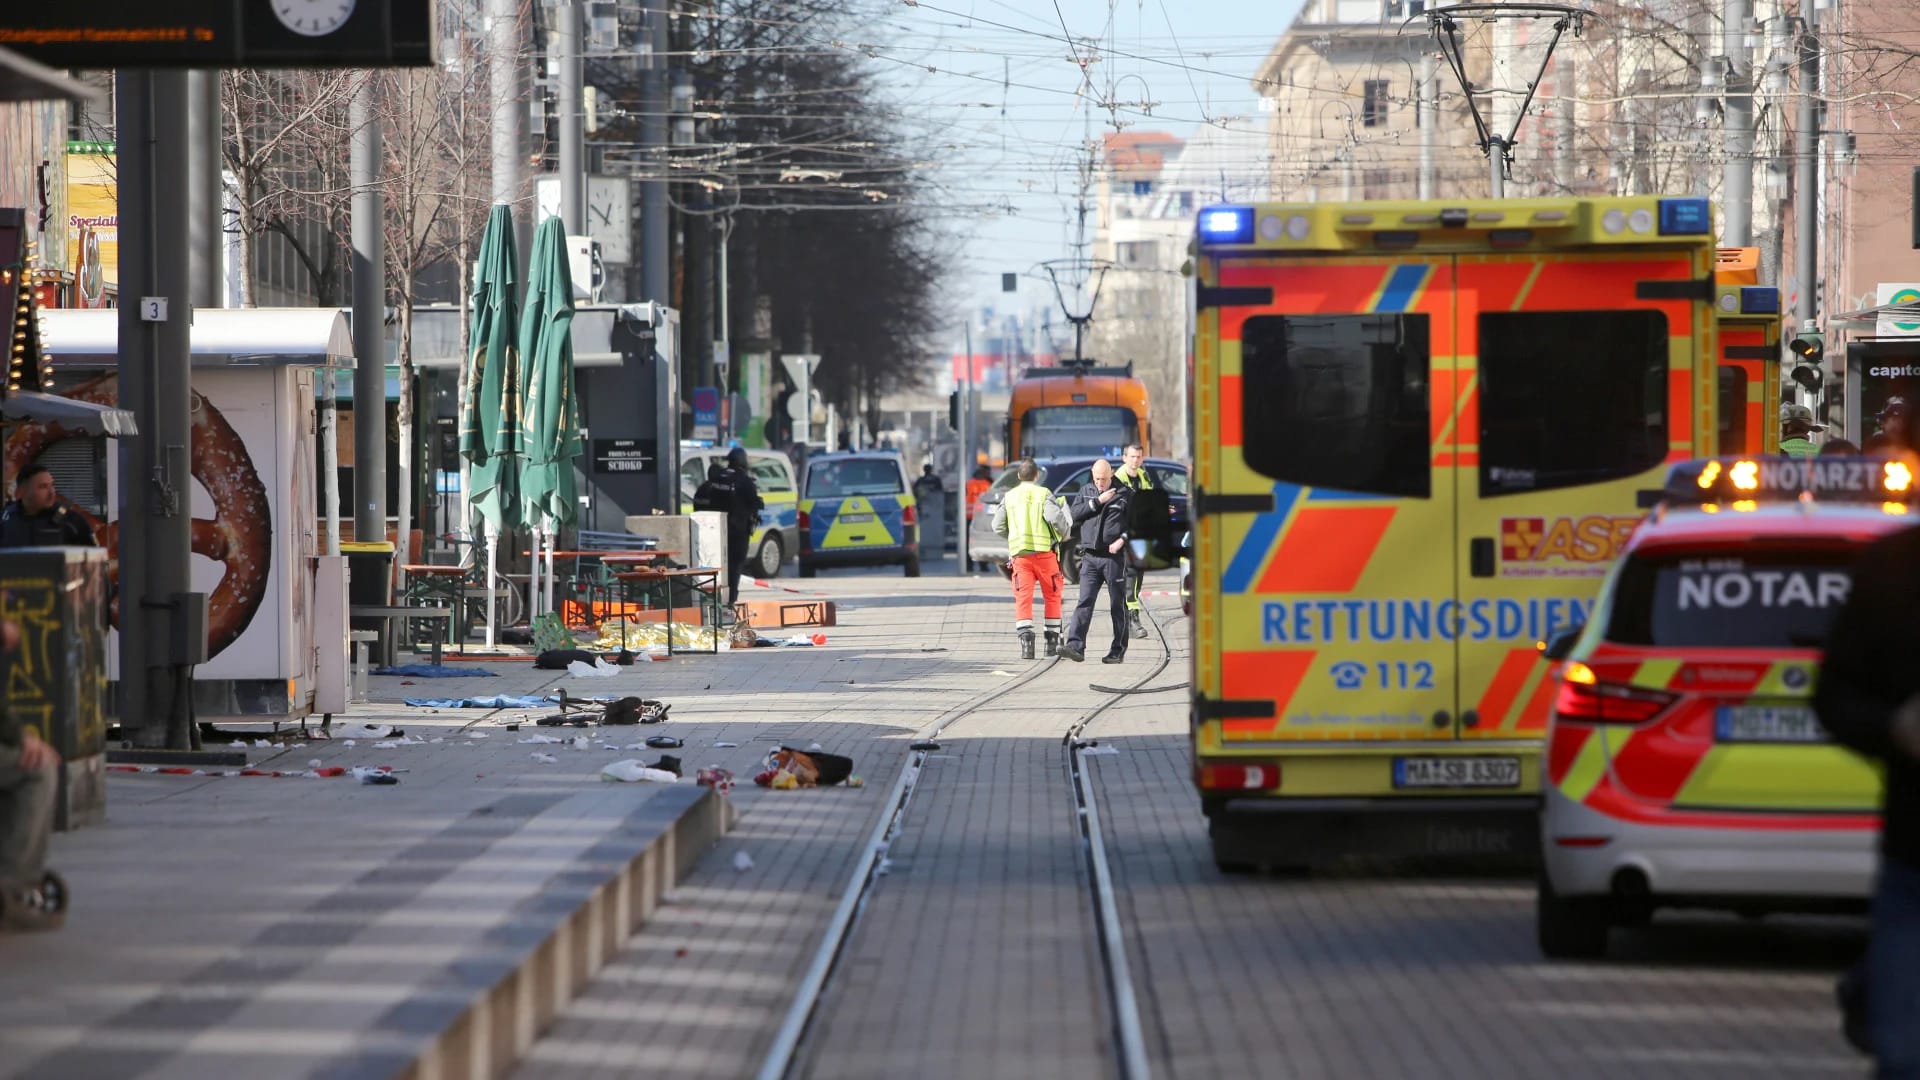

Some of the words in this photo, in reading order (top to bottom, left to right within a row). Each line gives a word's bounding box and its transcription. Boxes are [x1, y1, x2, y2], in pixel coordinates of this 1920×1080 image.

[150, 302, 158, 319] 3
[608, 460, 642, 471] SCHOKO
[1762, 462, 1880, 490] NOTARZT
[1376, 660, 1436, 690] 112
